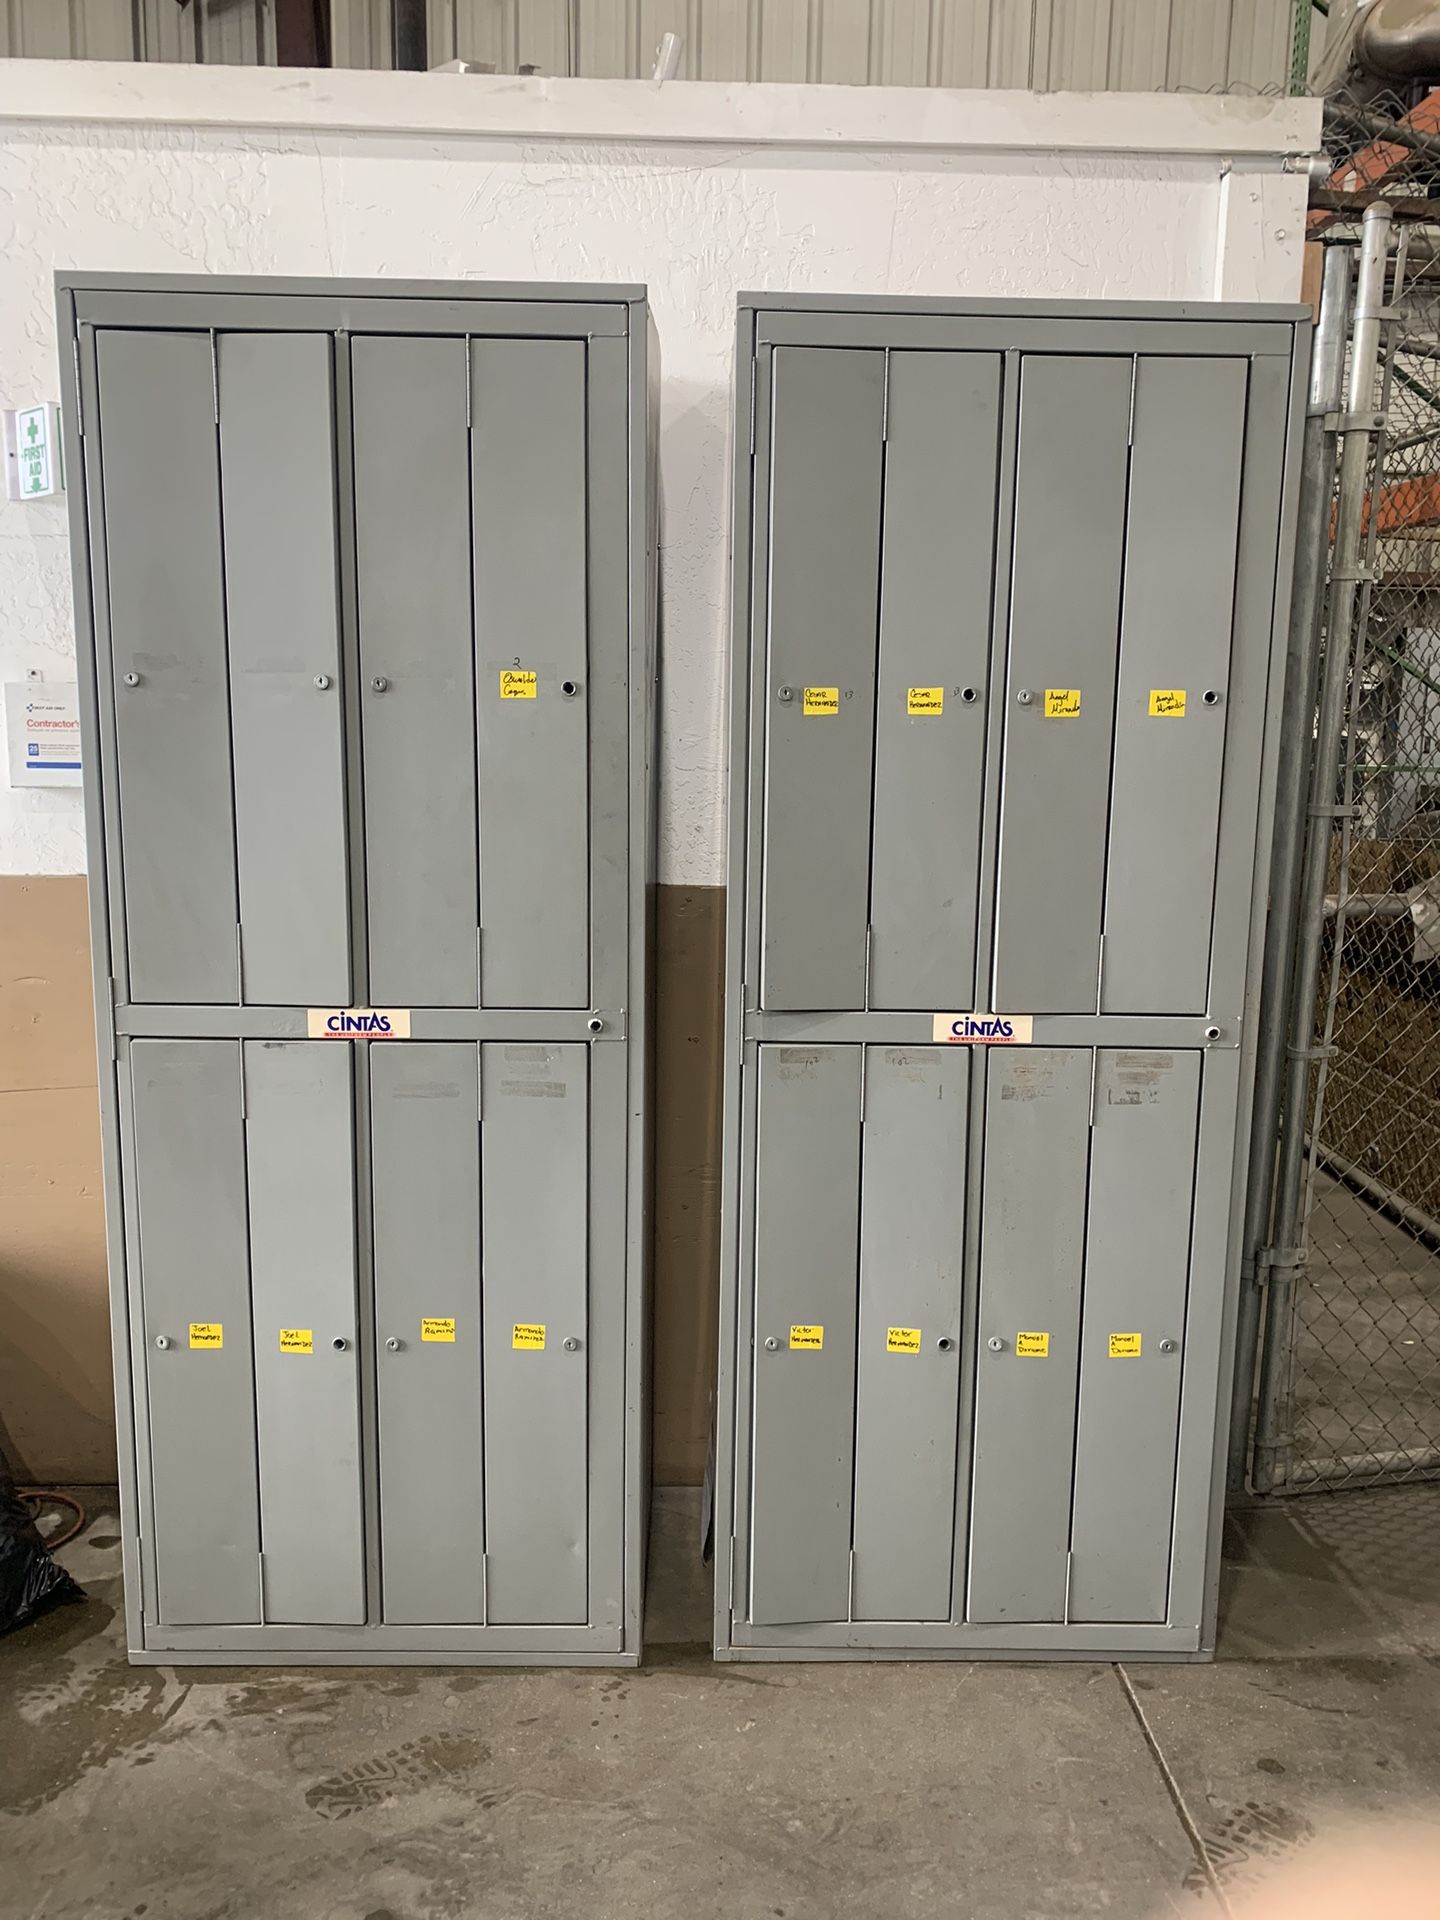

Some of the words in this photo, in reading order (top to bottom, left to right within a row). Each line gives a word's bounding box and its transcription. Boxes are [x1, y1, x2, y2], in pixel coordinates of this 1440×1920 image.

[23, 444, 45, 461] FIRST
[29, 461, 42, 476] AID
[513, 657, 522, 669] 2
